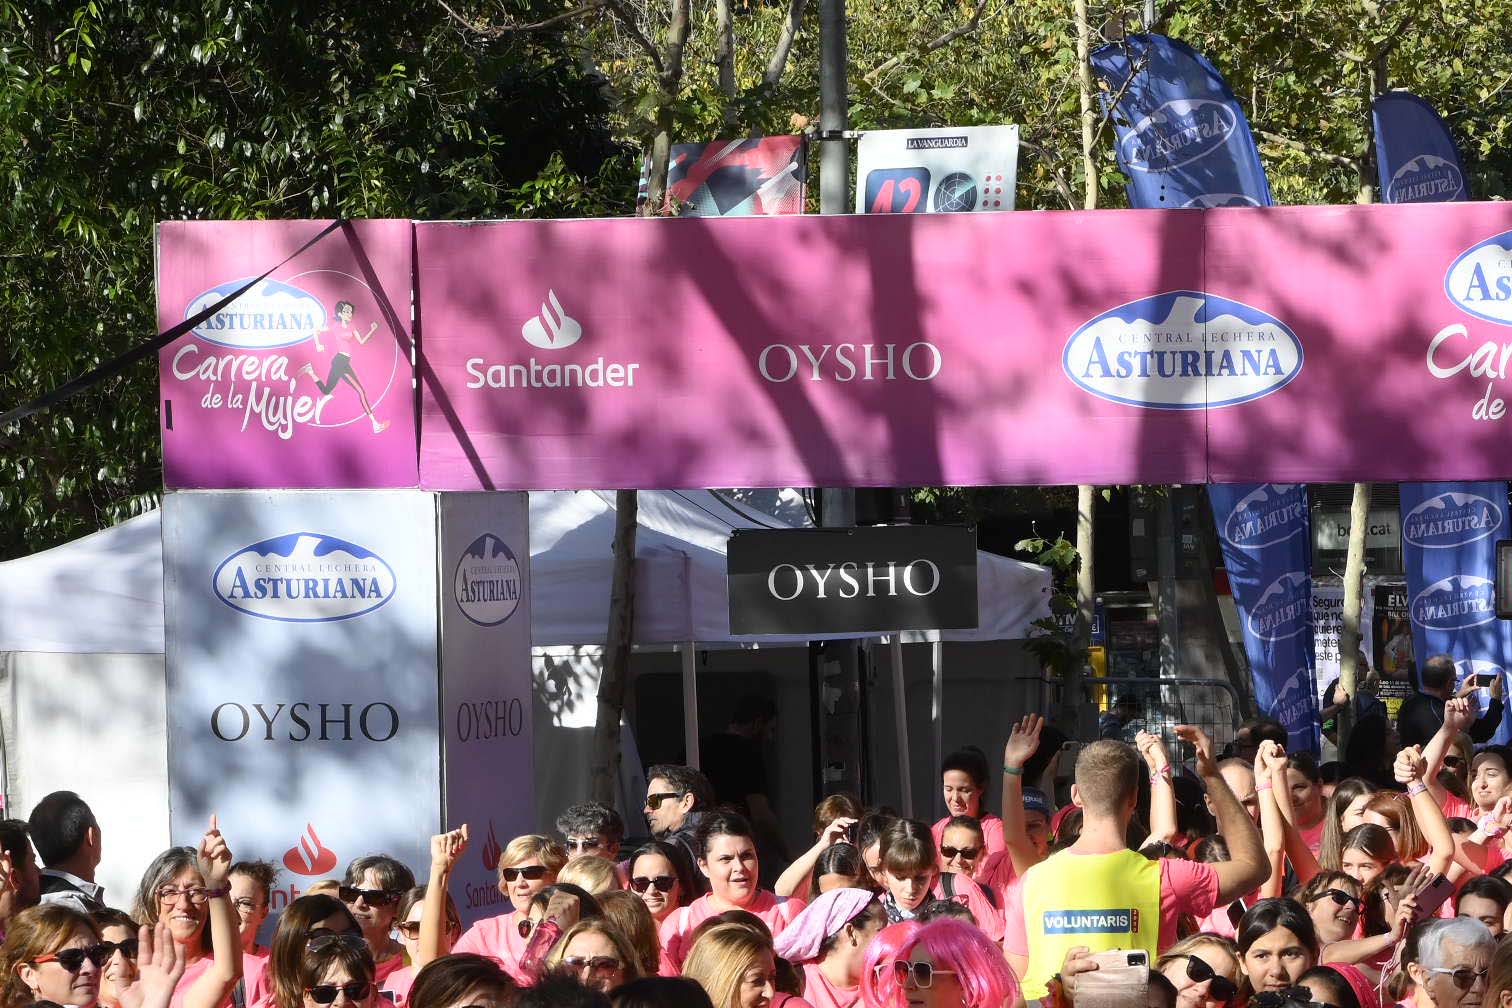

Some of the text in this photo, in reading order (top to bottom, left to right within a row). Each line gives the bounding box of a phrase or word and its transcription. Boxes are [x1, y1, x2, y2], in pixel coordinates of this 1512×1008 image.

[1118, 331, 1278, 343] CENTRAL LECHERA
[172, 344, 289, 381] Carrera
[466, 357, 639, 389] Santander
[758, 341, 942, 383] OYSHO
[1082, 335, 1285, 379] ASTURIANA
[201, 379, 333, 439] de la Mujer
[1472, 382, 1506, 421] de
[228, 566, 382, 600] ASTURIANA
[255, 563, 313, 573] CENTRAL
[767, 559, 940, 600] OYSHO
[460, 573, 518, 603] ASTURIANA
[210, 702, 400, 743] OYSHO
[457, 698, 523, 743] OYSHO
[1044, 915, 1128, 930] VOLUNTARIS
